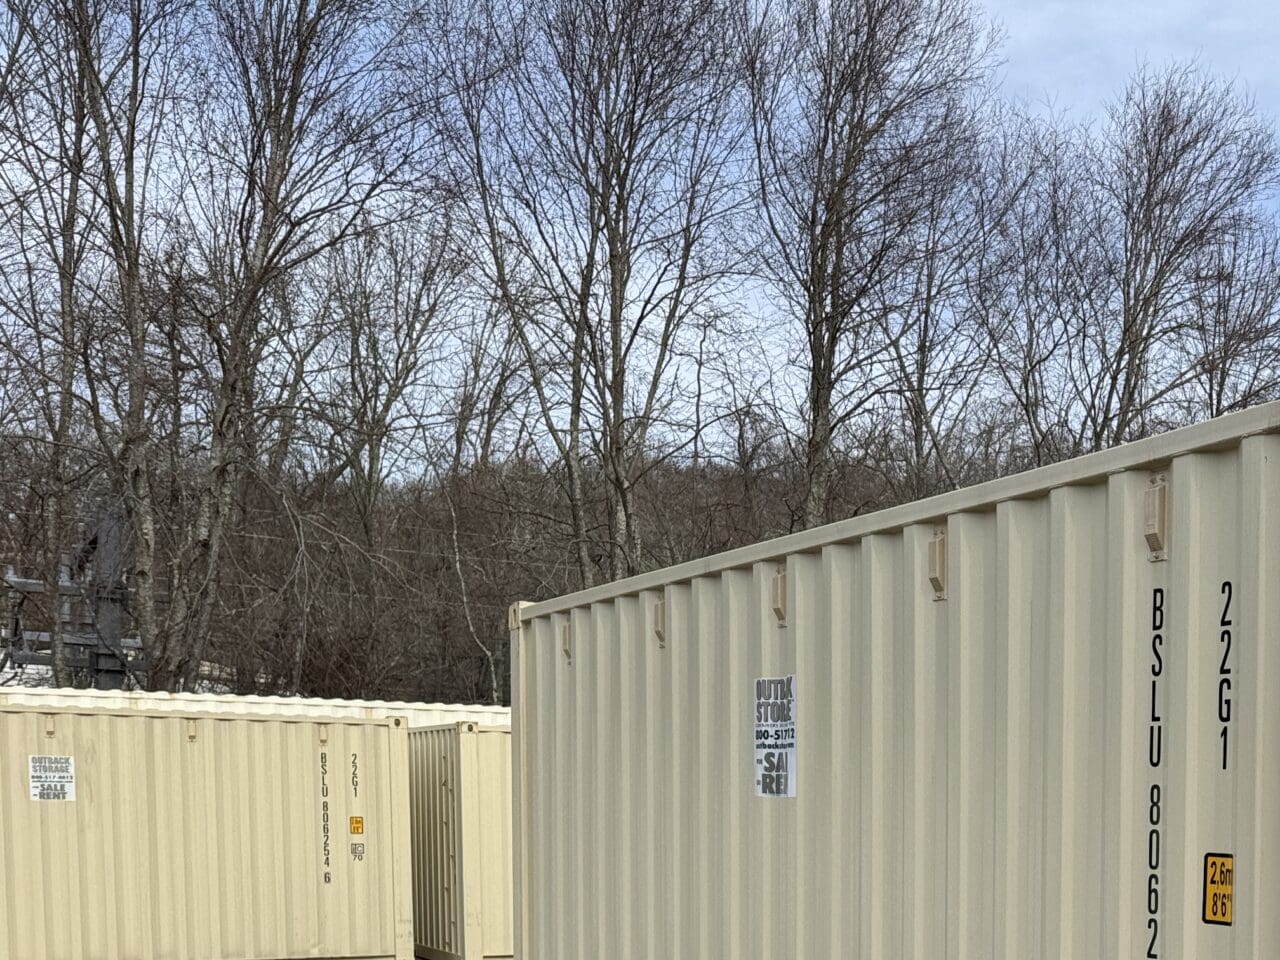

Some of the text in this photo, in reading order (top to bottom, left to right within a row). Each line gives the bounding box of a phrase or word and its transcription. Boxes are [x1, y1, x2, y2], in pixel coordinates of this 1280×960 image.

[1150, 588, 1164, 767] BSLU
[1218, 581, 1232, 769] 22G1
[32, 757, 71, 765] OUTBACK
[32, 765, 70, 773] STORAGE
[40, 784, 66, 792] SALE
[39, 792, 67, 800] RENT
